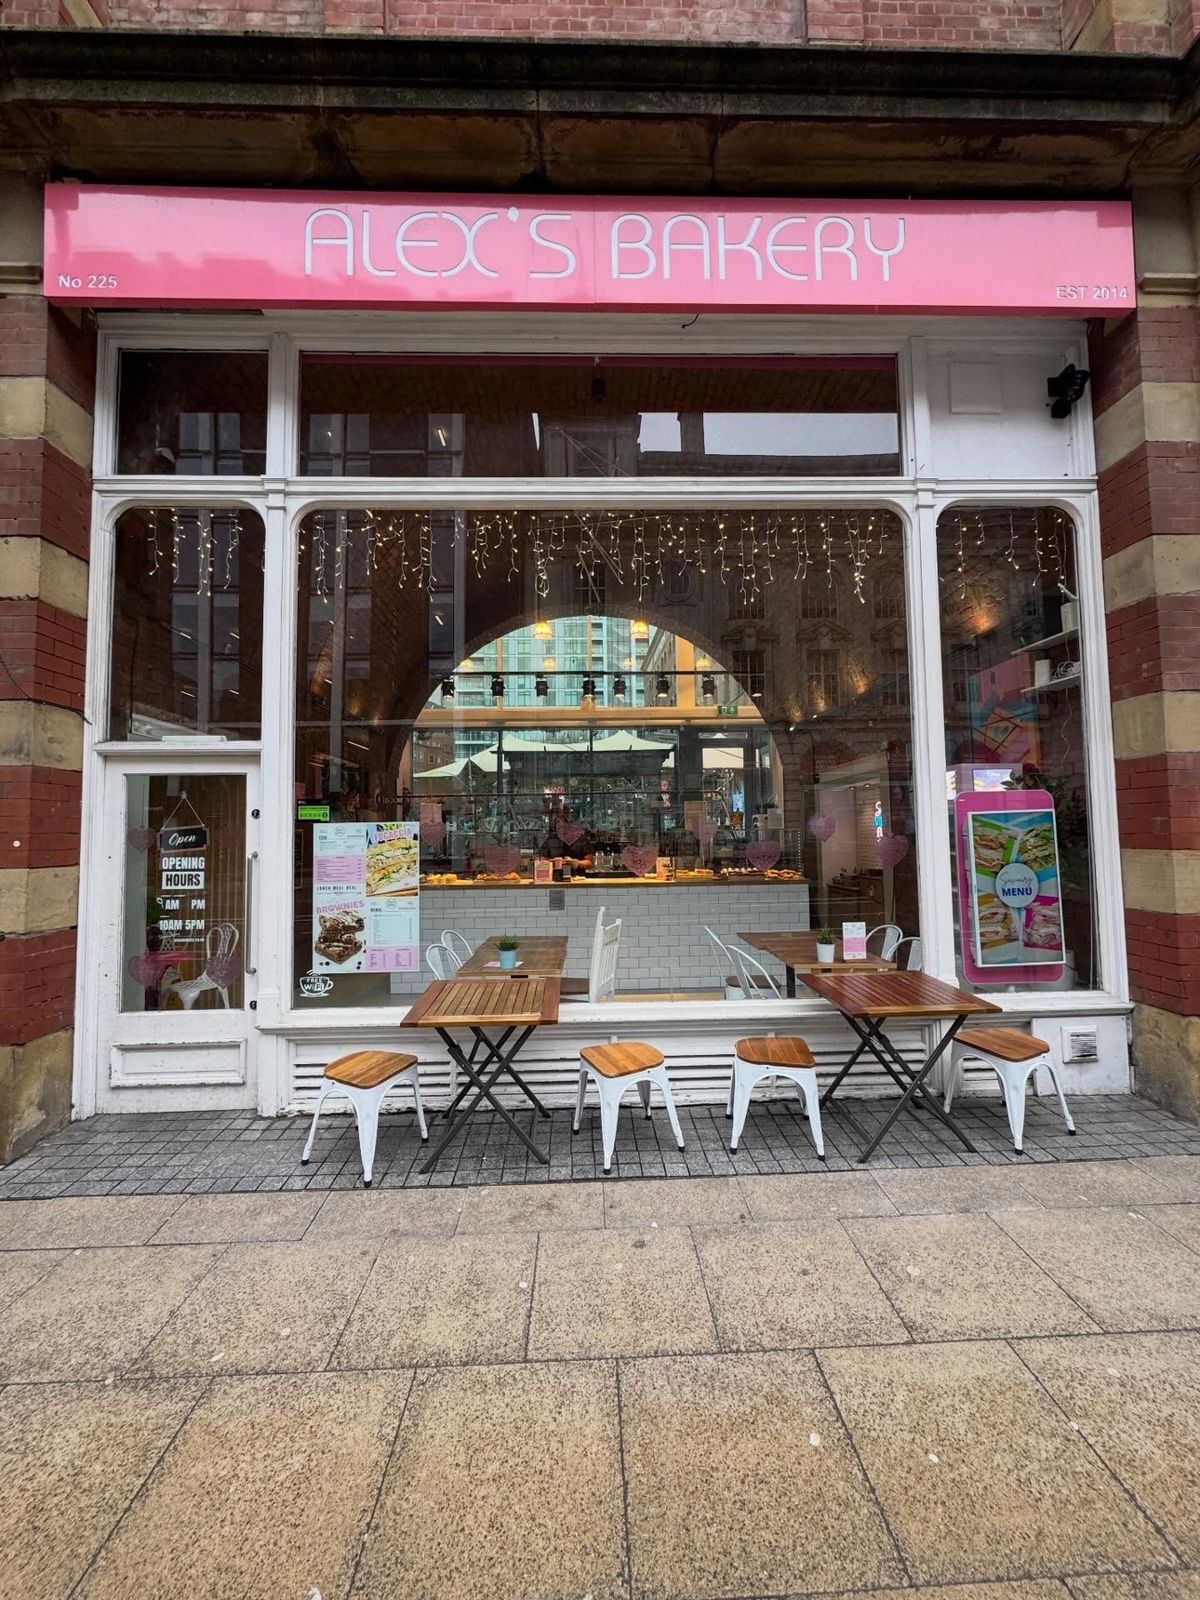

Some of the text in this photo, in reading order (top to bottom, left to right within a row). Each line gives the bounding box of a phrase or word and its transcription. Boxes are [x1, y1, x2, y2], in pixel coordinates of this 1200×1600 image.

[304, 206, 906, 281] ALEX'S BAKERY
[58, 274, 118, 289] No 225
[1056, 286, 1129, 300] EST 2014
[168, 832, 196, 846] Open
[374, 827, 412, 841] FOCACCIA
[162, 857, 205, 870] OPENING
[165, 873, 201, 887] HOURS
[1001, 887, 1032, 897] MENU
[316, 900, 364, 914] BROWNIES
[159, 919, 205, 930] 10AM 5PM
